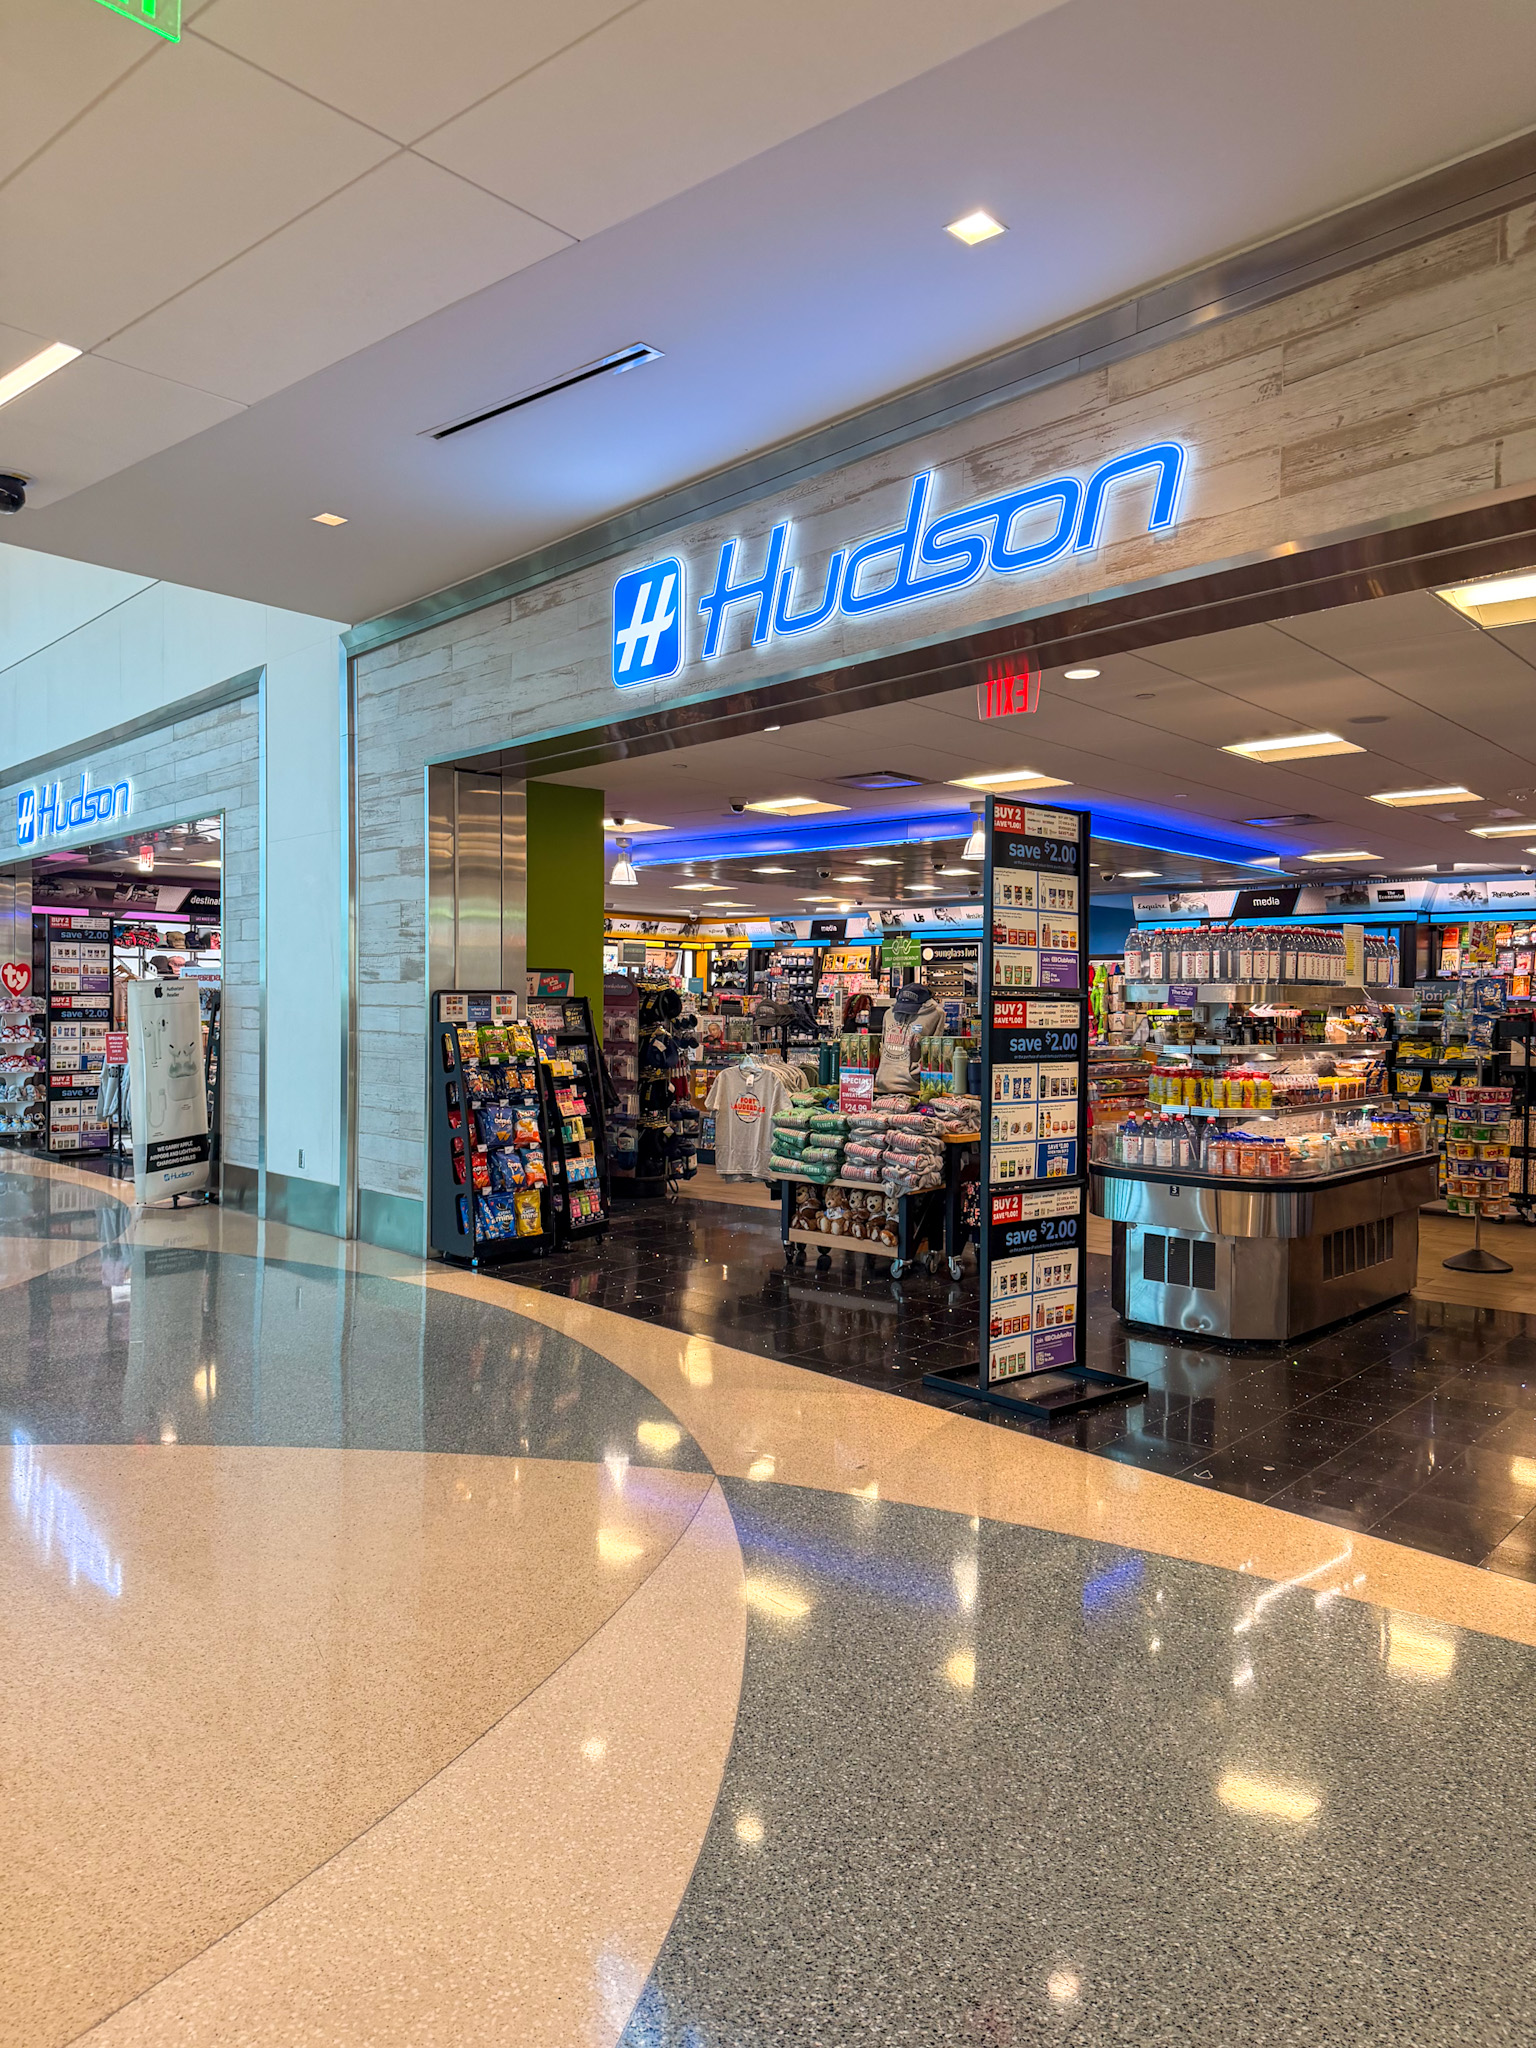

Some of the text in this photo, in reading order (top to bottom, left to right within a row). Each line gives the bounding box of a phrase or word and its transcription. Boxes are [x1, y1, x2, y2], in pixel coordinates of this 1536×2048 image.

[698, 442, 1185, 661] Hudson
[38, 772, 131, 838] Hudson
[994, 806, 1021, 820] BUY 2
[1009, 841, 1076, 864] save $2.00
[1253, 897, 1280, 907] media
[913, 913, 925, 923] Us
[61, 930, 108, 940] save $2.00
[934, 948, 978, 960] sunglass hut
[4, 964, 28, 991] ty
[85, 1009, 109, 1018] $2.00
[994, 1004, 1023, 1015] BUY 2
[1010, 1031, 1078, 1052] save $2.00
[845, 1104, 867, 1112] $24.99
[170, 1170, 194, 1180] Hudson
[993, 1196, 1018, 1211] BUY 2
[1006, 1219, 1077, 1246] save $2.00
